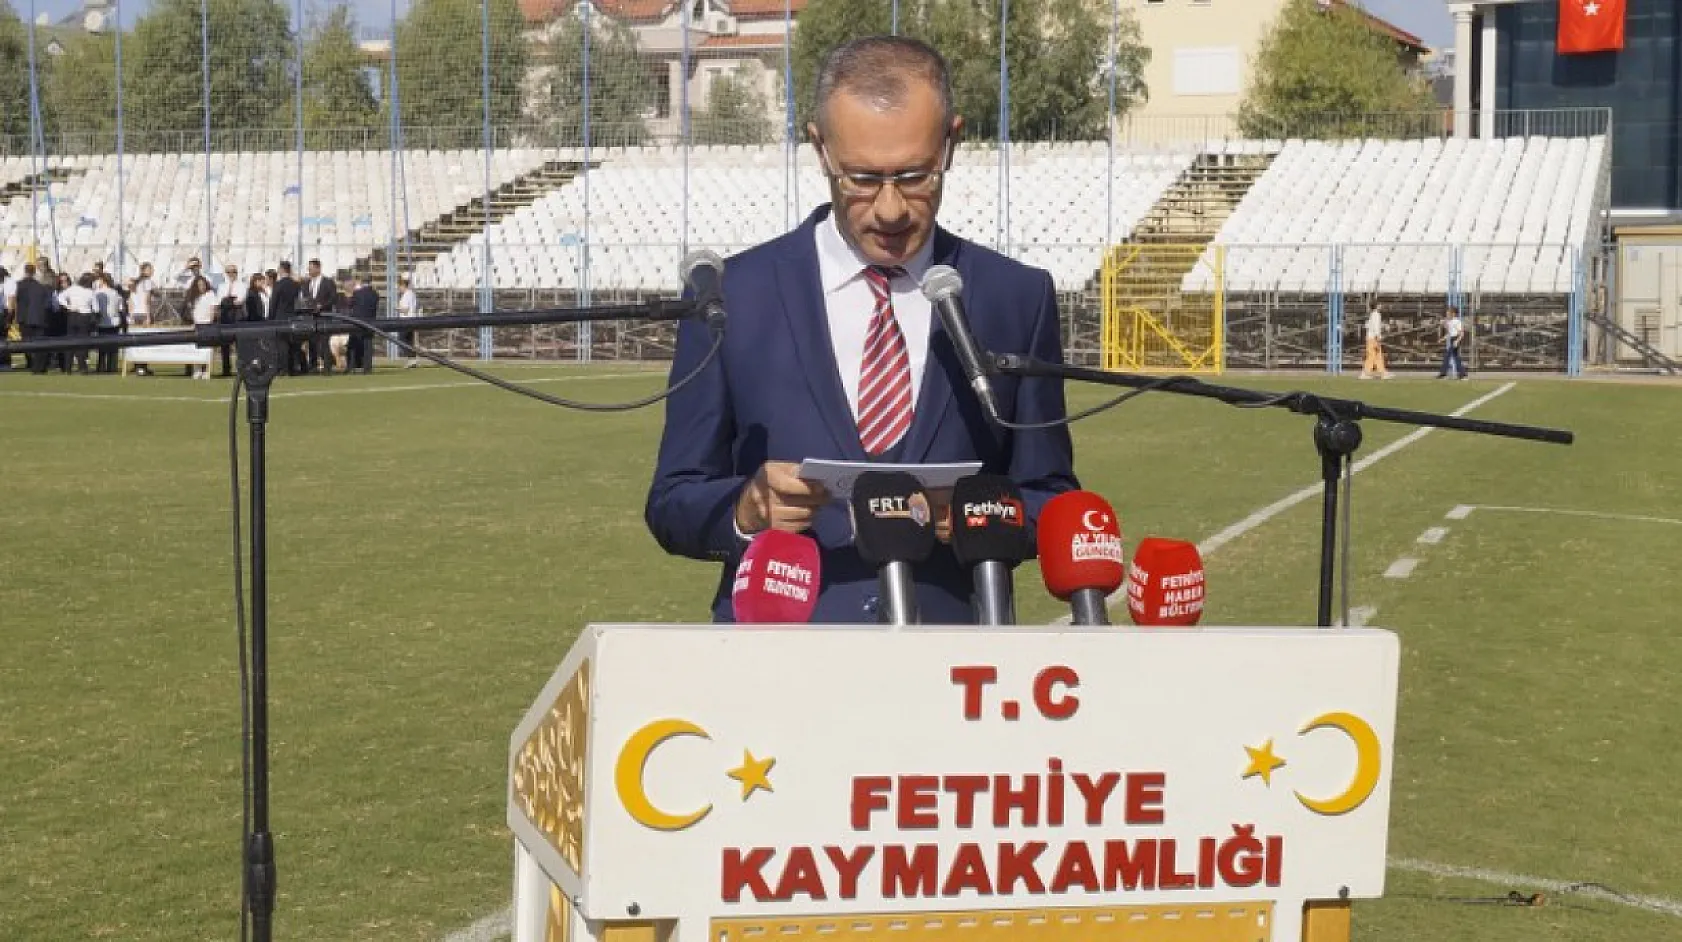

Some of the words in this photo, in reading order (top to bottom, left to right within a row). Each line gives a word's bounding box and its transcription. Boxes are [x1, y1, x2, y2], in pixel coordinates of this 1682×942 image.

[869, 497, 905, 513] FRT
[964, 499, 1017, 517] Fethiye
[1072, 533, 1090, 547] AY
[851, 758, 1165, 829] FETHİYE
[722, 823, 1283, 901] KAYMAKAMLIĞI
